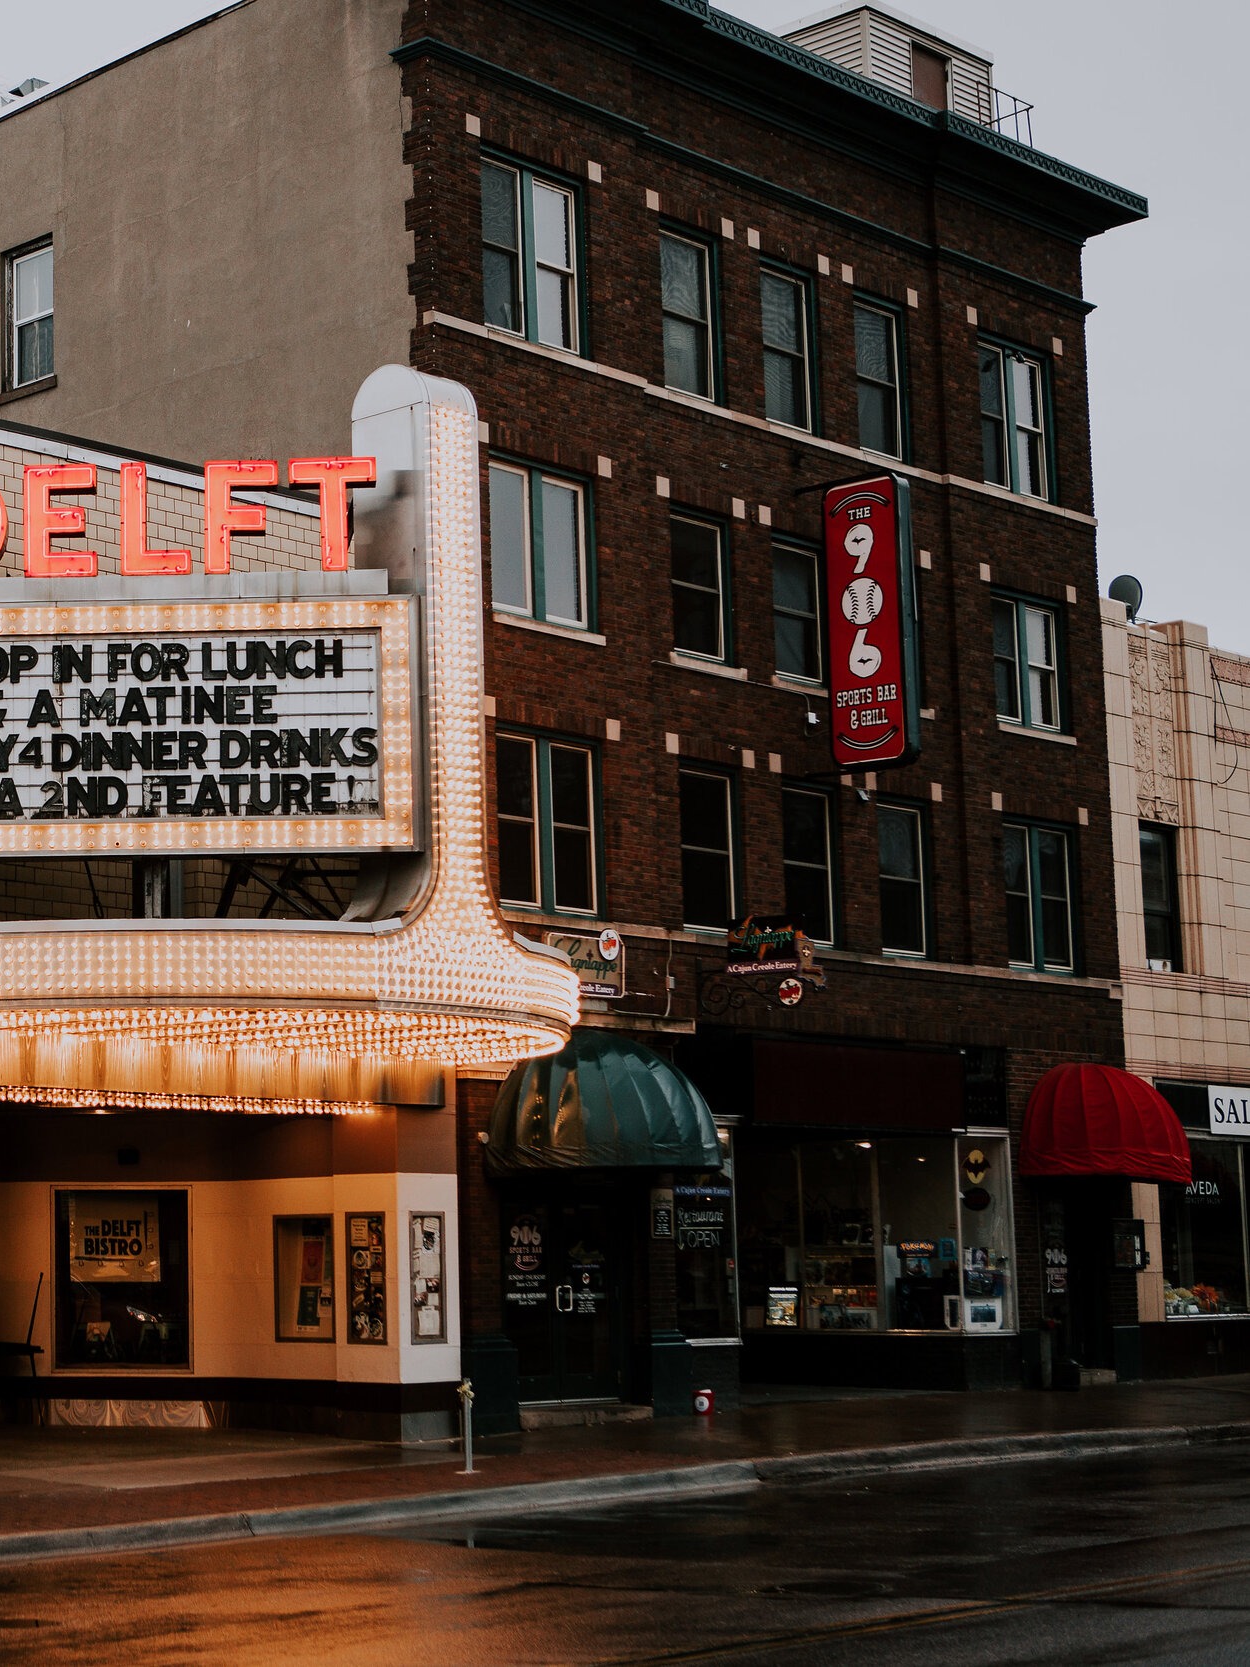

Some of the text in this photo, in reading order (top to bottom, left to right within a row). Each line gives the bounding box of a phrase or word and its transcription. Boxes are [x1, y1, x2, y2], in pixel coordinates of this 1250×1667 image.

[847, 507, 871, 521] THE
[52, 644, 93, 684] IN
[108, 643, 190, 682] FOR
[201, 639, 343, 680] LUNCH
[836, 684, 896, 708] SPORTS BAR
[26, 689, 61, 728] A
[79, 685, 278, 727] MATINEE
[850, 708, 888, 729] & GRILL
[52, 731, 208, 772] DINNER
[219, 727, 379, 769] DRINKS
[39, 776, 128, 816] 2ND
[730, 922, 795, 954] Lagniappe
[733, 964, 752, 975] Cajun
[752, 962, 775, 971] Creole
[775, 961, 798, 970] Eatery
[579, 983, 615, 996] reole Eatery
[1185, 1181, 1219, 1195] AVEDA
[84, 1219, 141, 1237] THE DELFT
[84, 1237, 142, 1256] BISTRO
[687, 1230, 721, 1248] OPEN
